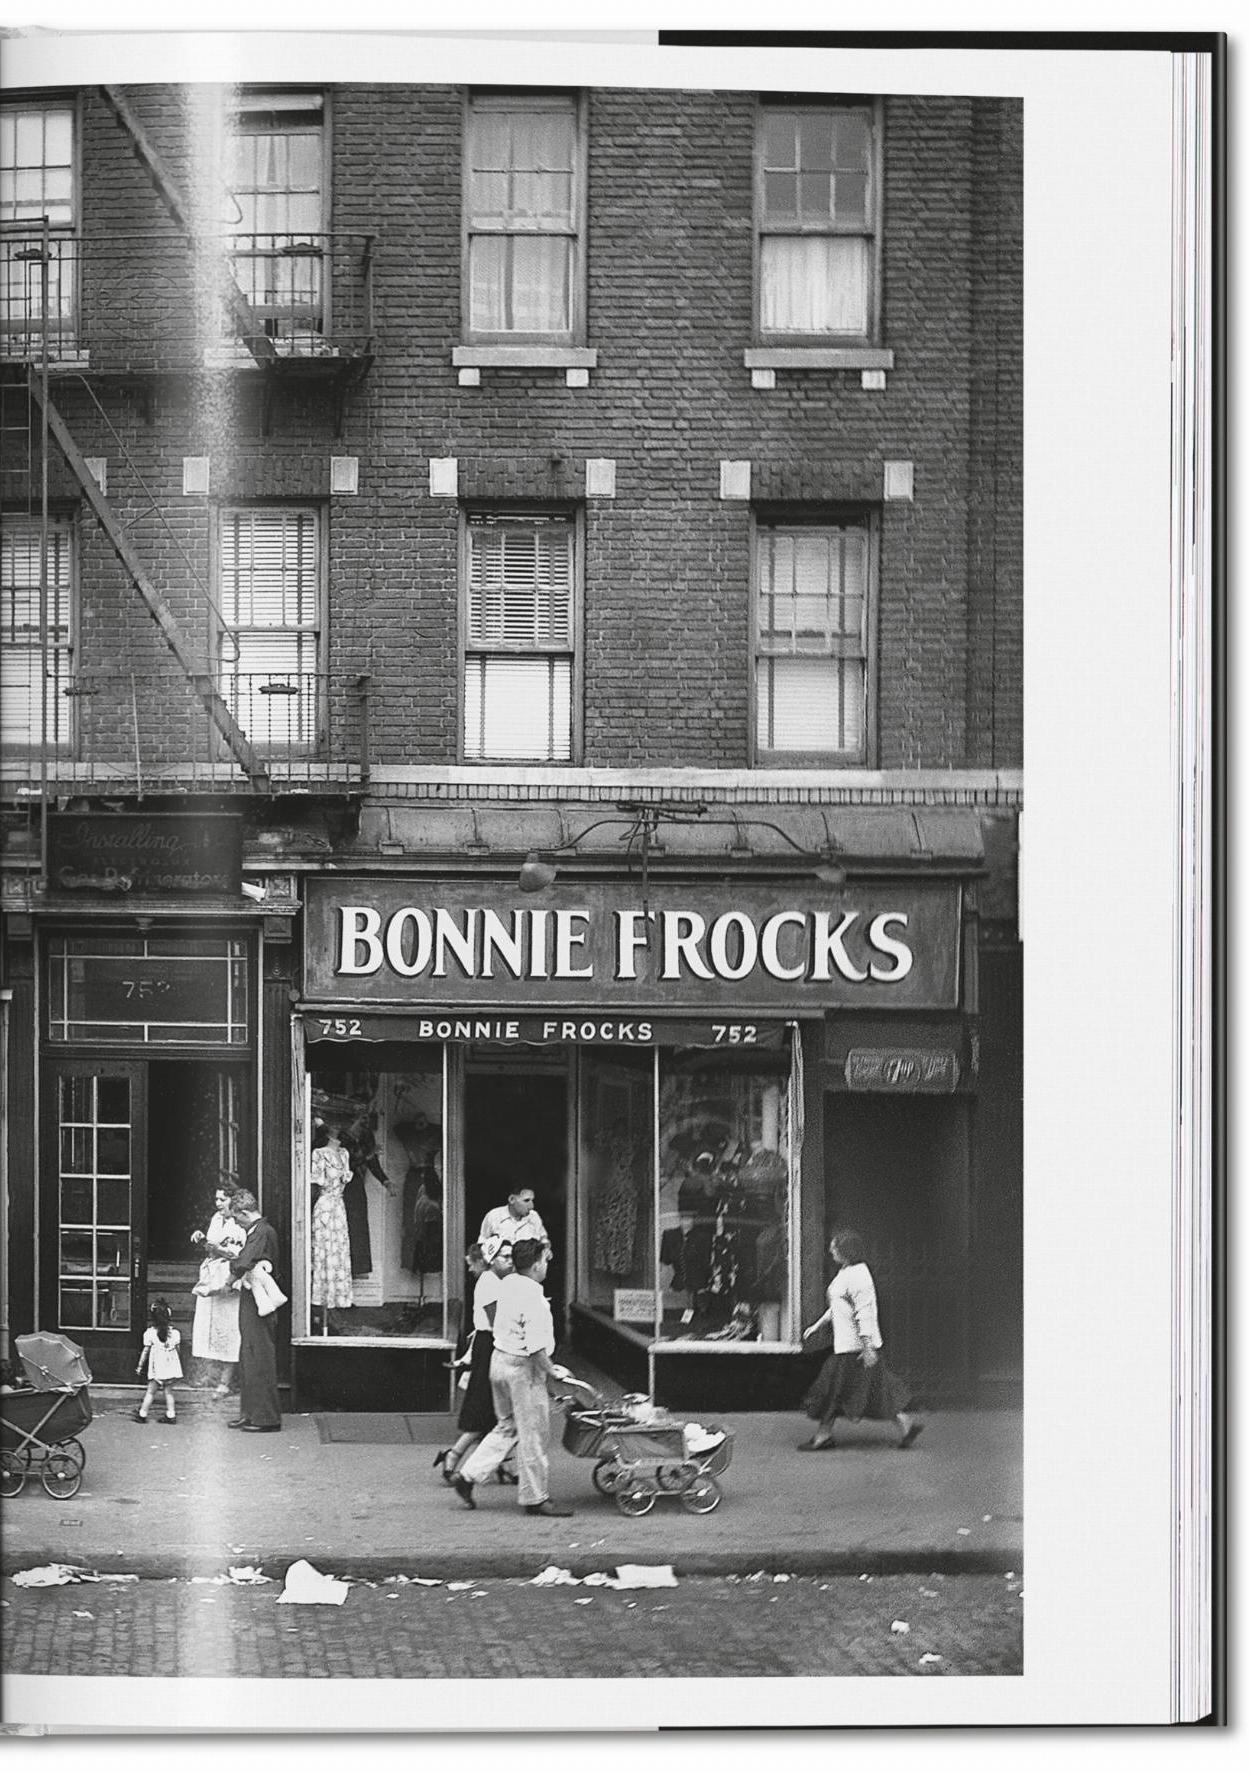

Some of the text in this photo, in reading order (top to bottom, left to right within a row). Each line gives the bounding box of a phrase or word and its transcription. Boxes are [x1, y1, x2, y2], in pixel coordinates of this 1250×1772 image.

[339, 906, 913, 981] BONNIE FROCKS
[319, 1019, 757, 1044] 752 BONNIE FROCKS 752
